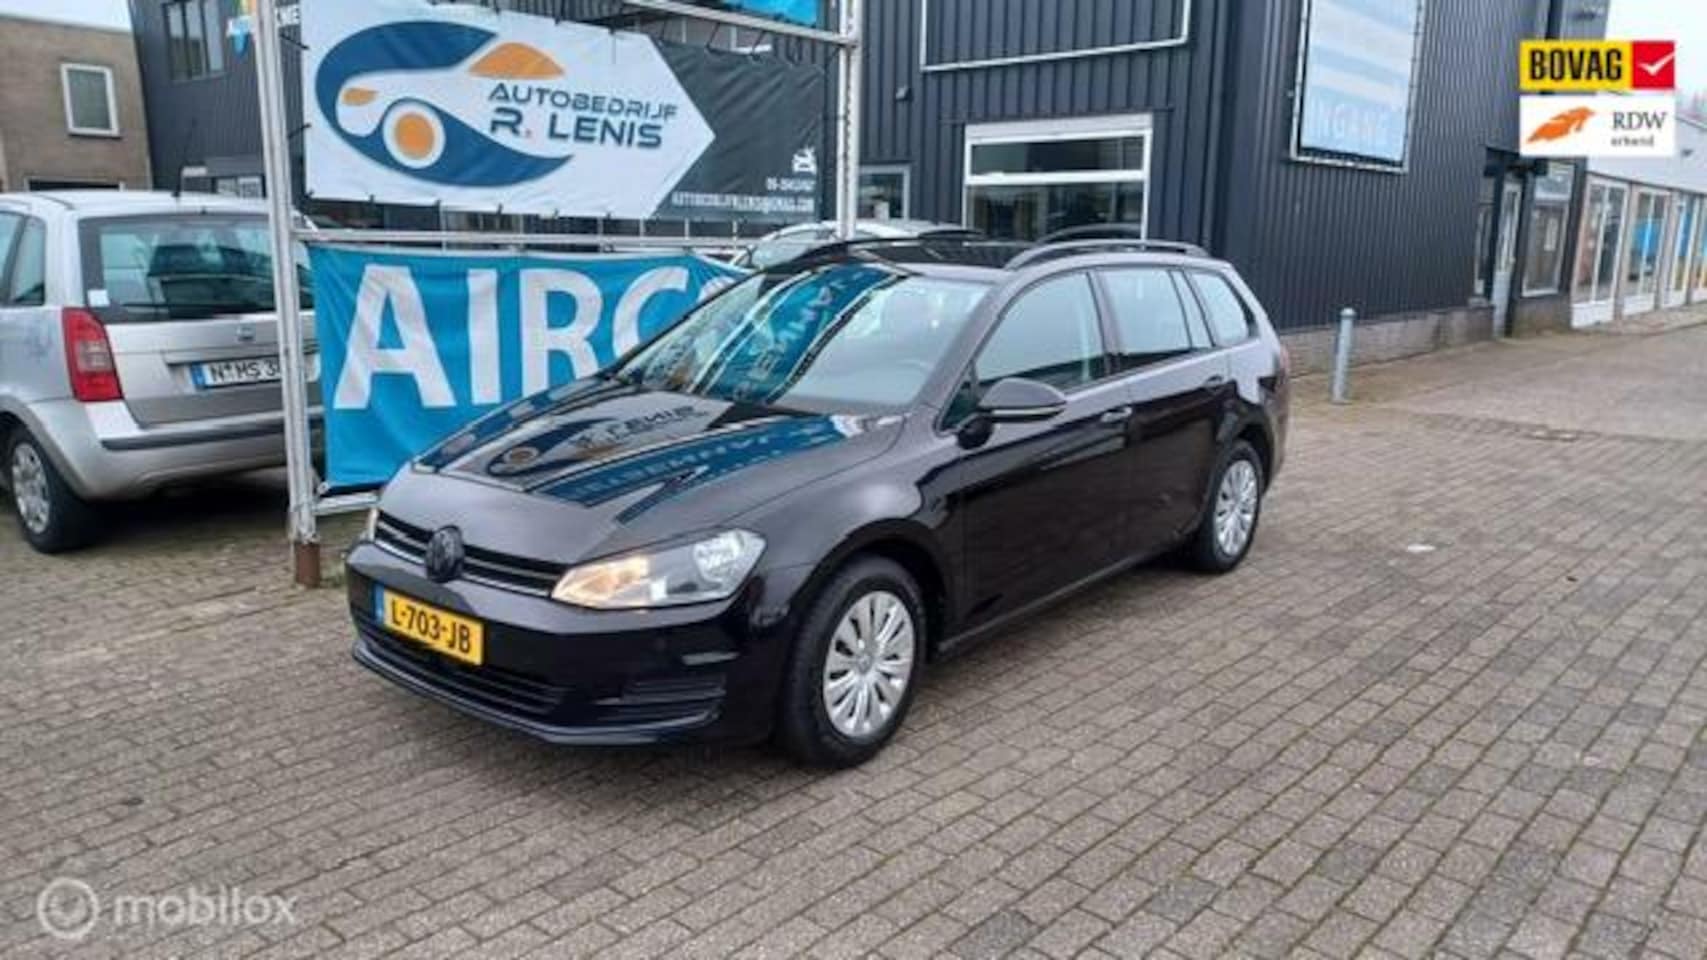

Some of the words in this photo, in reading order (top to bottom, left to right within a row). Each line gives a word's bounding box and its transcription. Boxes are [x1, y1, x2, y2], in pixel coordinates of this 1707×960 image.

[488, 82, 679, 120] AUTOBEDRIJF
[490, 107, 532, 138] R.
[548, 113, 663, 149] LENIS
[334, 264, 737, 409] AIRC
[391, 599, 471, 654] L-703-JB
